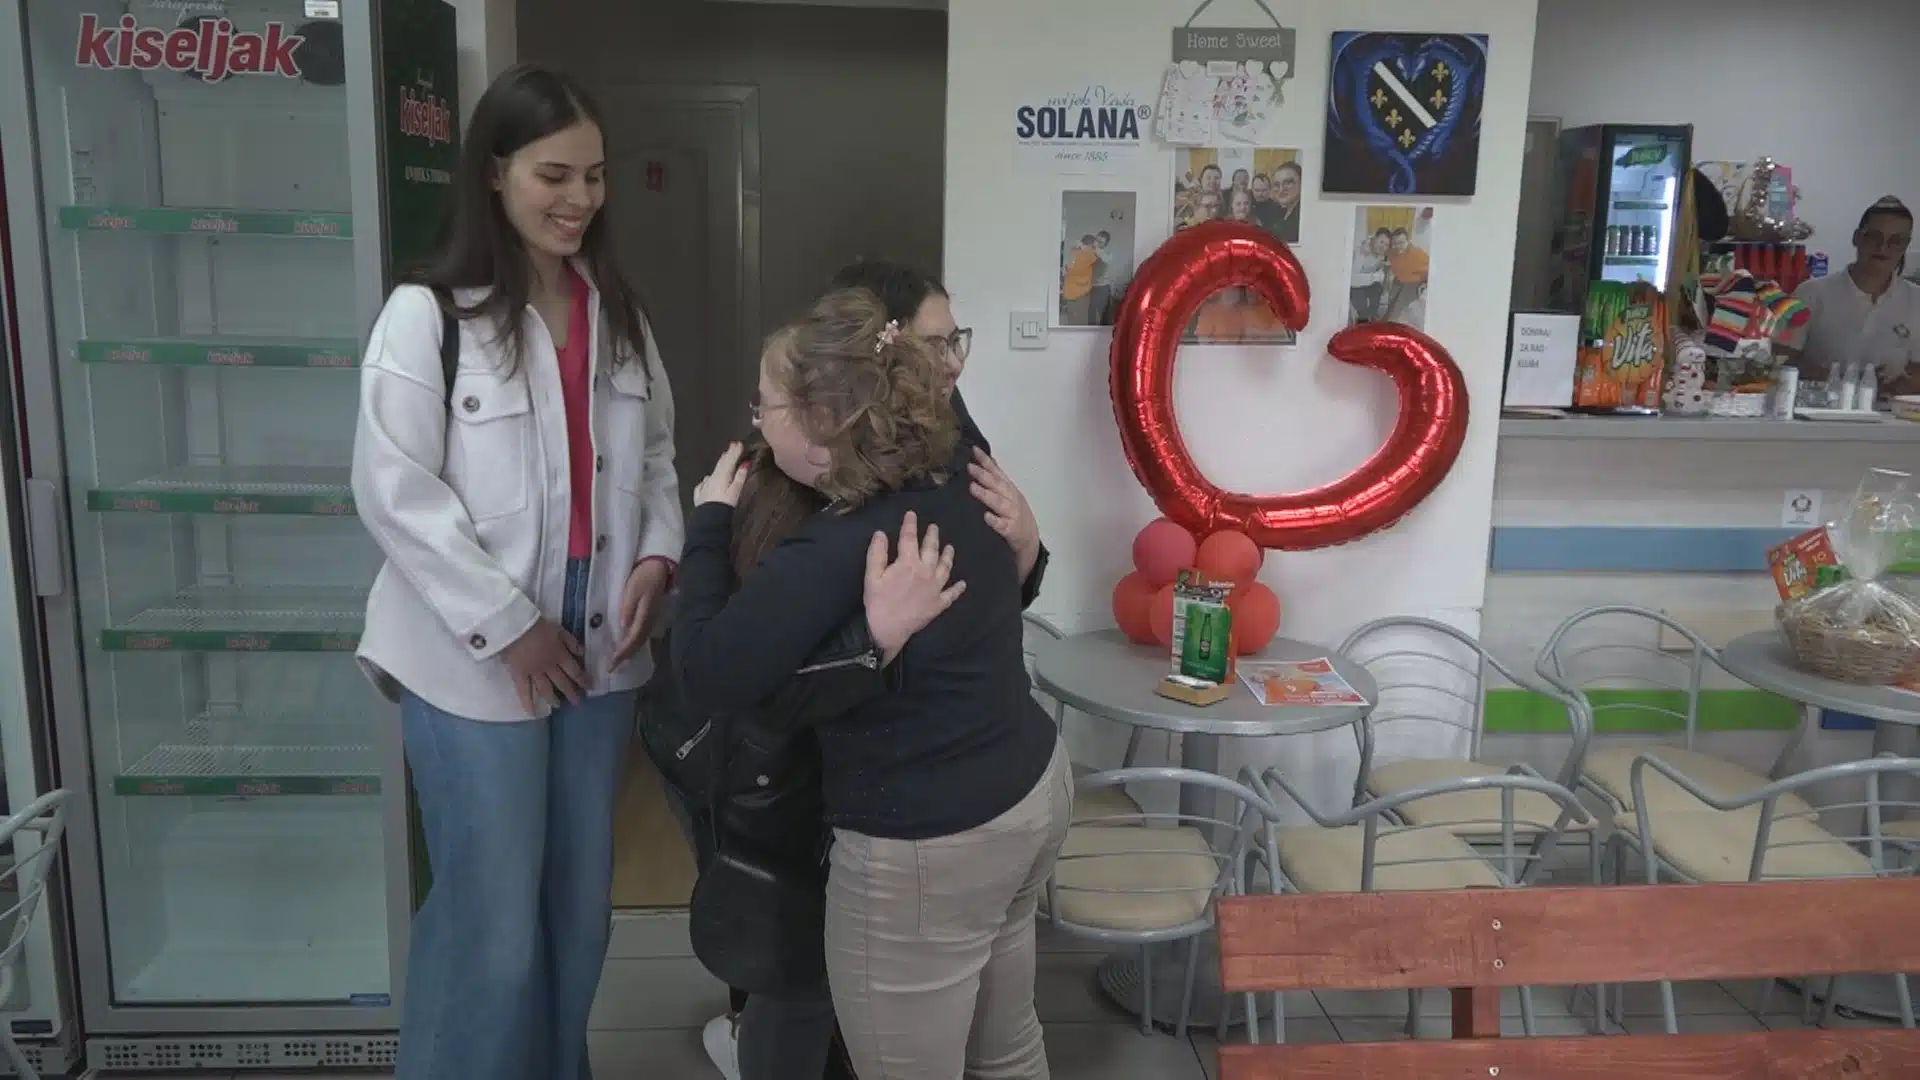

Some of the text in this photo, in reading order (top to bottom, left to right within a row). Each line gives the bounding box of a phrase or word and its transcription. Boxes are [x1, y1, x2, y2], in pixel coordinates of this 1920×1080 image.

[76, 12, 305, 83] kiseljak
[1187, 31, 1282, 49] Home Sweet
[1612, 322, 1654, 369] Vita
